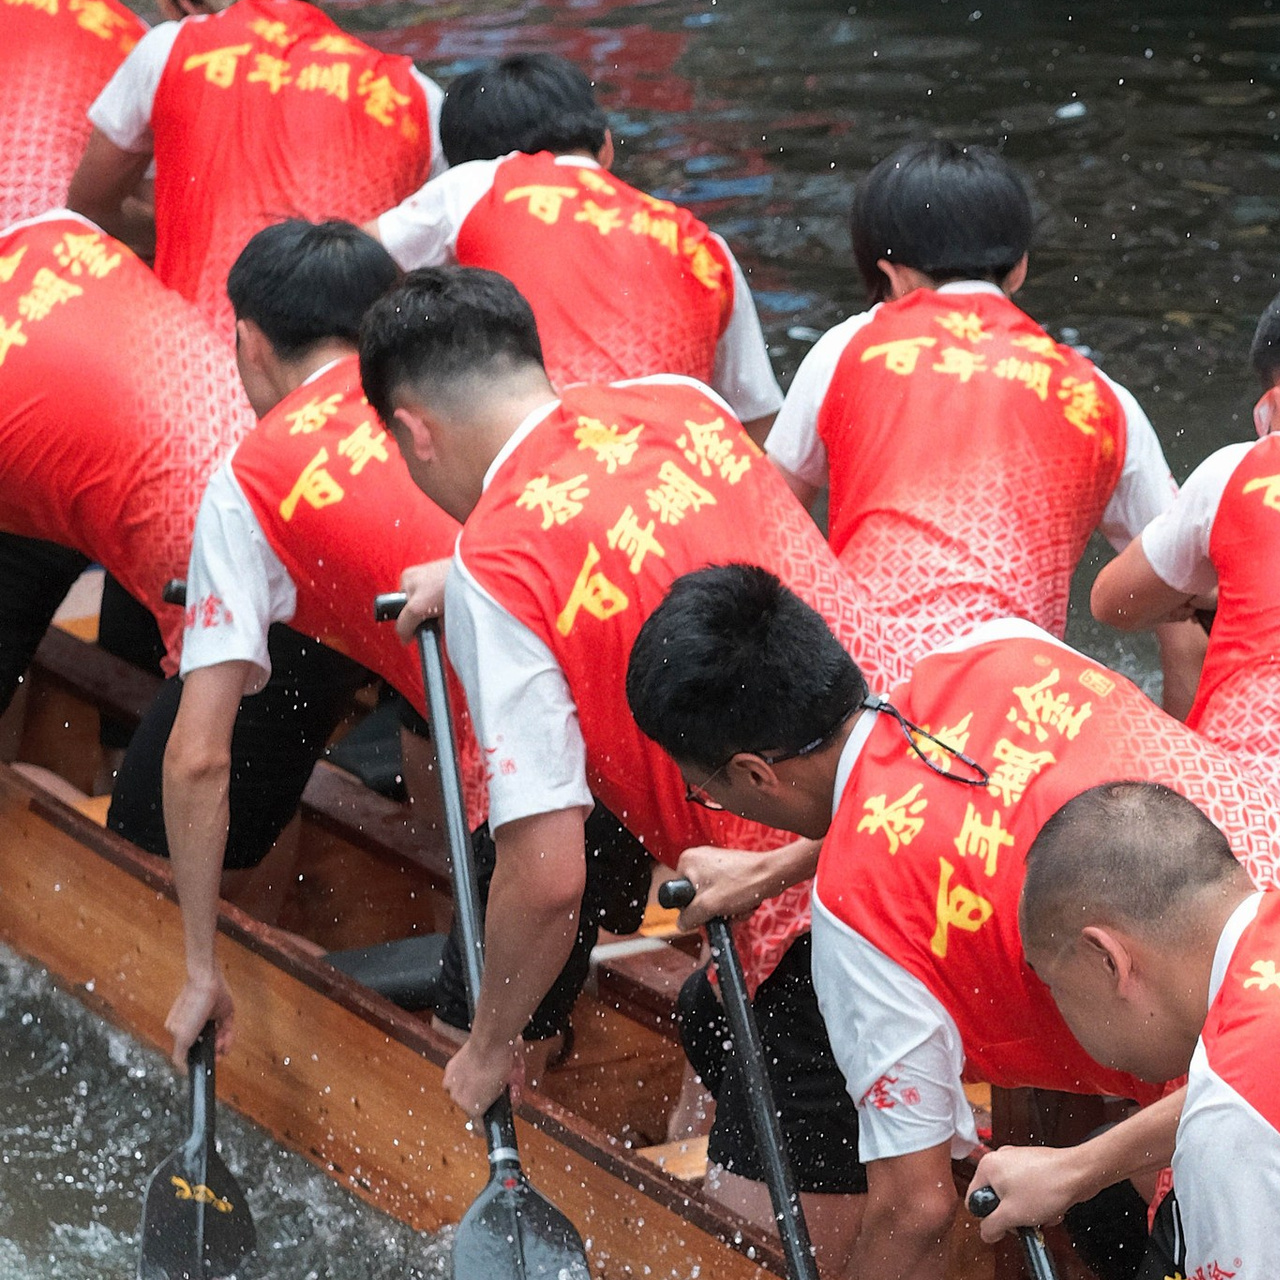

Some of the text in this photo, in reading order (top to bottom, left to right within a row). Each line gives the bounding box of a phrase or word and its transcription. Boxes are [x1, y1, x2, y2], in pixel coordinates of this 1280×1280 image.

[183, 43, 411, 126] 百年糊塗
[860, 336, 1108, 436] 百年糊塗
[278, 420, 389, 523] 百年
[556, 417, 751, 637] 百年糊塗
[930, 667, 1093, 959] 百年糊塗
